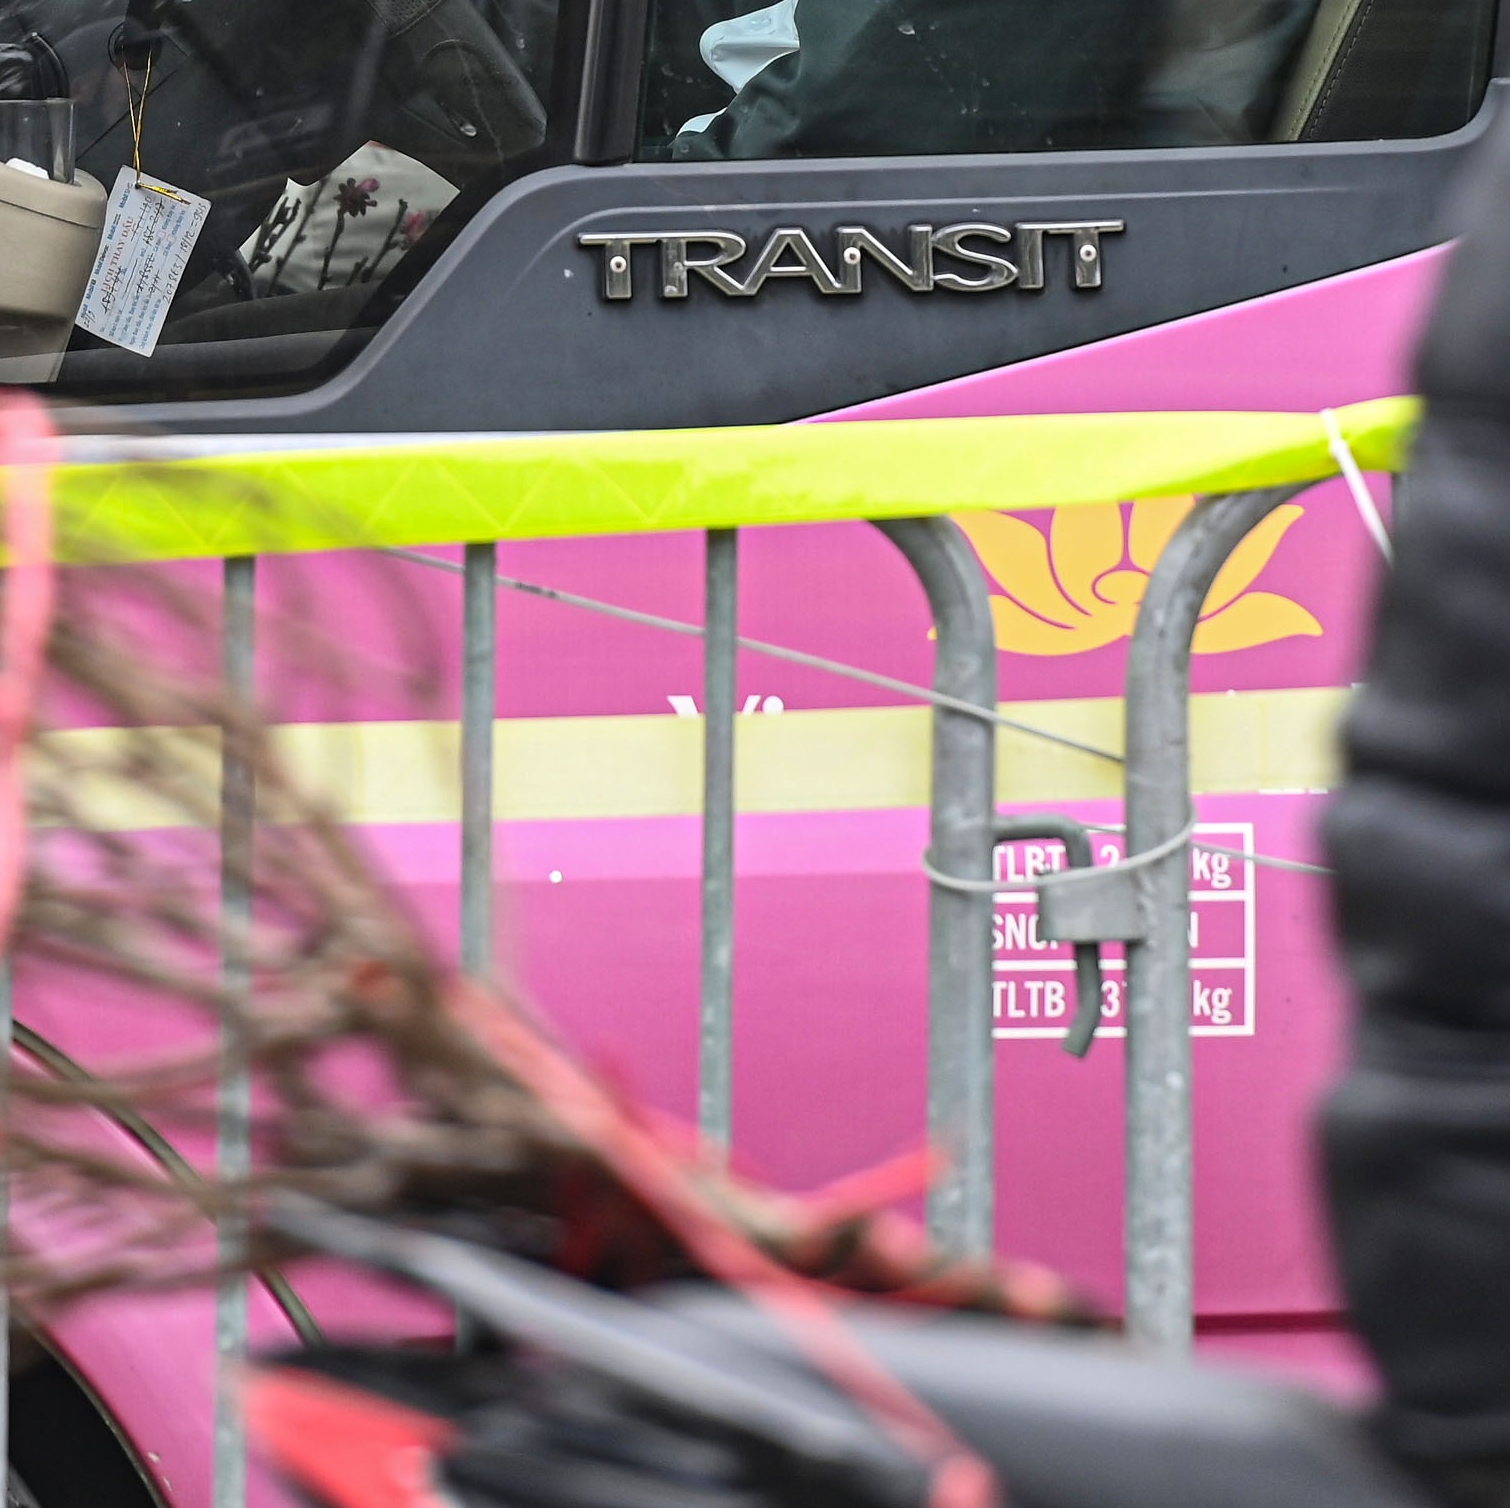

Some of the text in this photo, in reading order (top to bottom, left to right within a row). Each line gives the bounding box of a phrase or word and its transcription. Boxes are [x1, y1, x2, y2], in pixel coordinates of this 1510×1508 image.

[578, 219, 1125, 300] TRANSIT
[1192, 848, 1233, 889] kg
[991, 912, 1060, 950] SNC
[992, 980, 1066, 1019] TLTB
[1193, 980, 1233, 1025] kg
